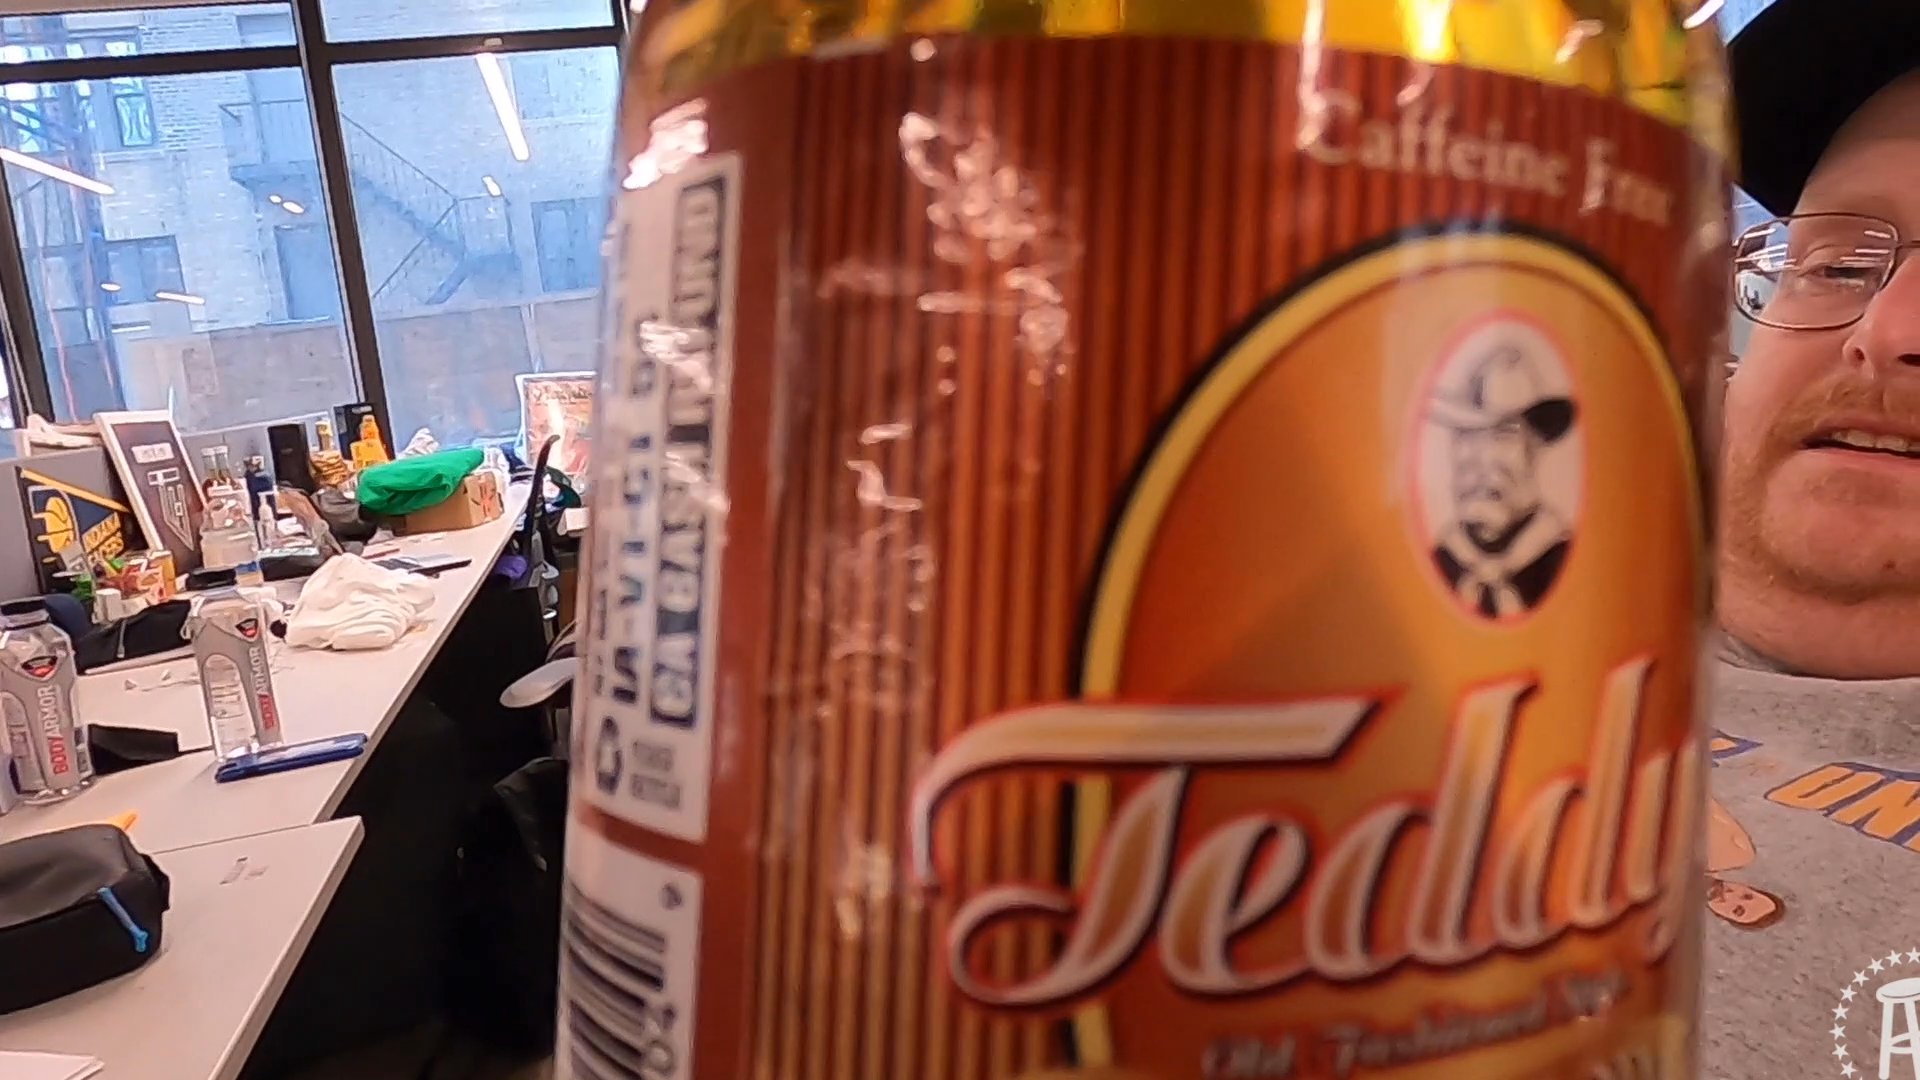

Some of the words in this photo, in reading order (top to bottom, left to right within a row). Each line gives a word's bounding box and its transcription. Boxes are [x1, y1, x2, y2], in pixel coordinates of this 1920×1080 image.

[1300, 88, 1569, 197] Caffeine
[668, 185, 723, 426] RUND
[37, 684, 69, 775] BODYARMOR
[912, 655, 1698, 1007] Teddy
